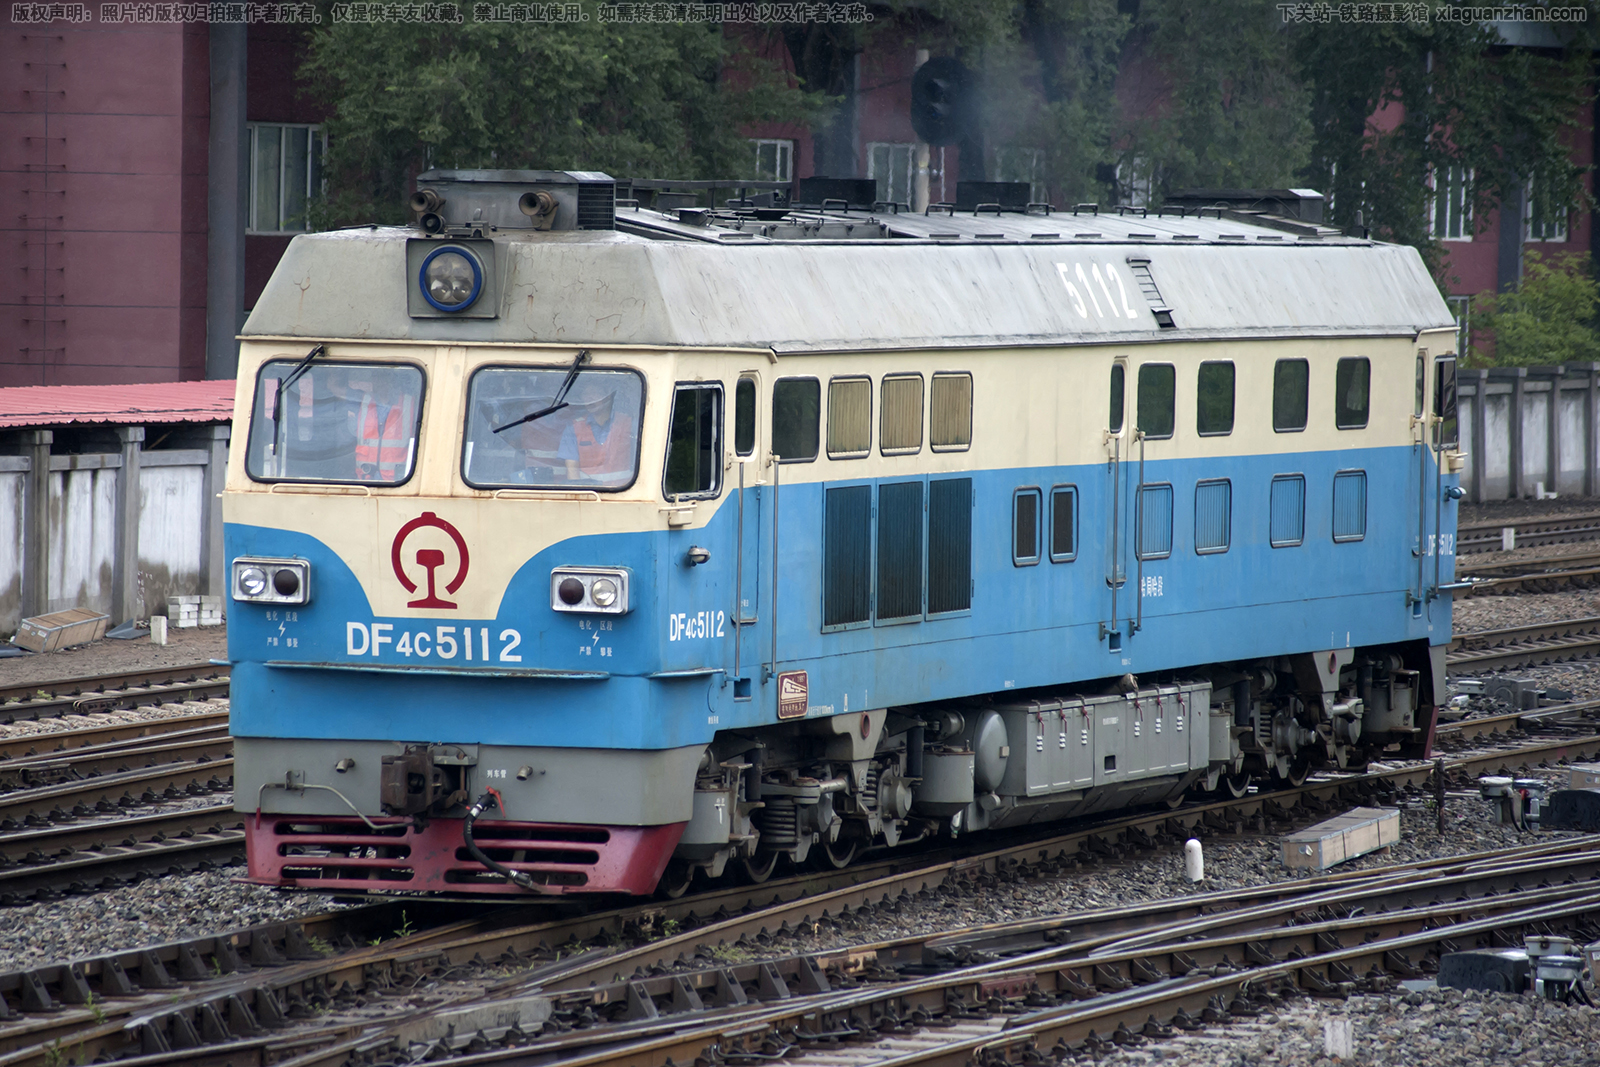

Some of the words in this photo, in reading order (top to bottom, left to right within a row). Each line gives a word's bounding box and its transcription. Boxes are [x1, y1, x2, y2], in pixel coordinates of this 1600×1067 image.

[1056, 263, 1138, 319] 5112
[347, 621, 522, 662] DF4C5112
[669, 610, 725, 642] DF4C5112
